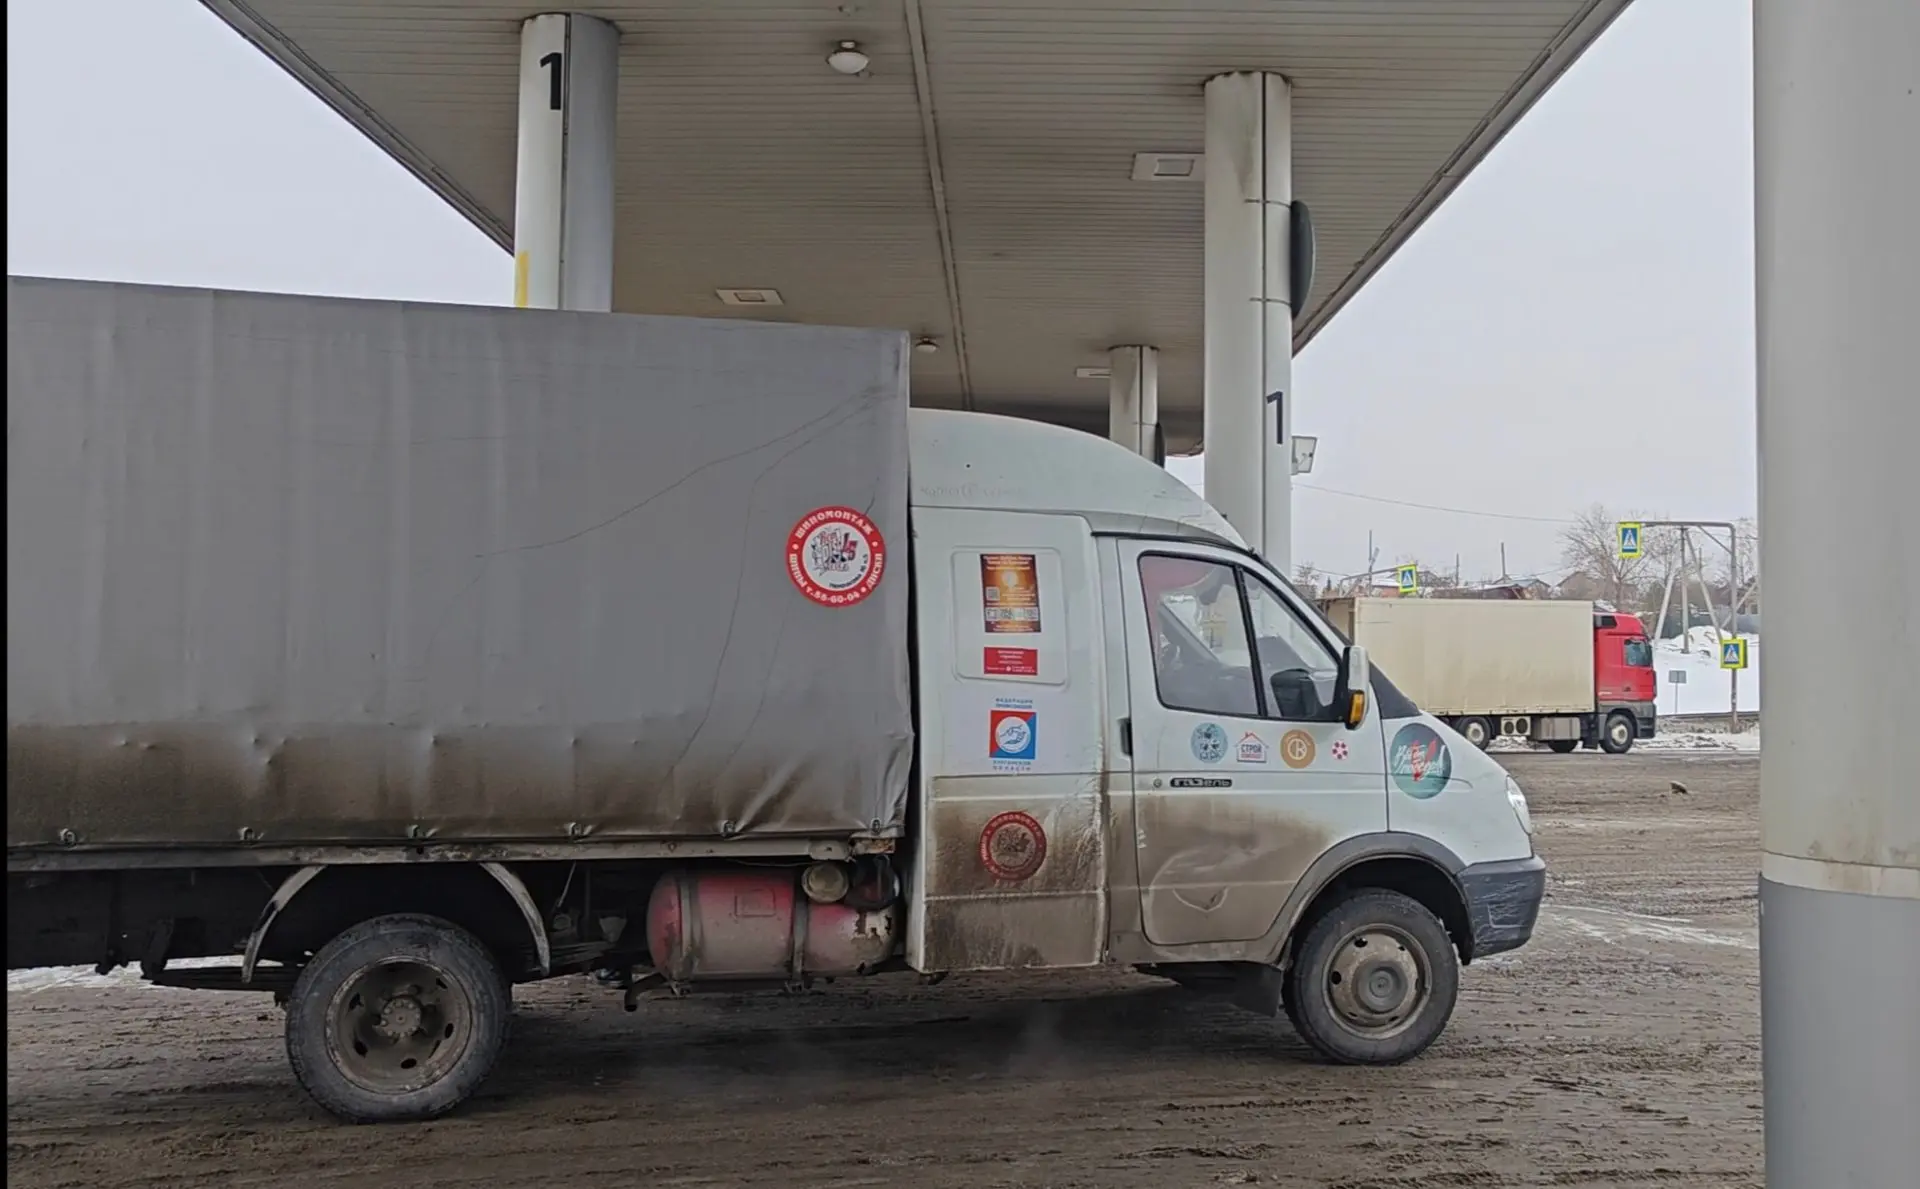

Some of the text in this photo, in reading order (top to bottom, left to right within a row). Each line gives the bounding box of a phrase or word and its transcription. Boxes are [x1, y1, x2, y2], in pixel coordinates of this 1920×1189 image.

[540, 52, 562, 110] 1
[1266, 391, 1283, 444] 1
[794, 510, 873, 539] ШИНОМОНТАЖ
